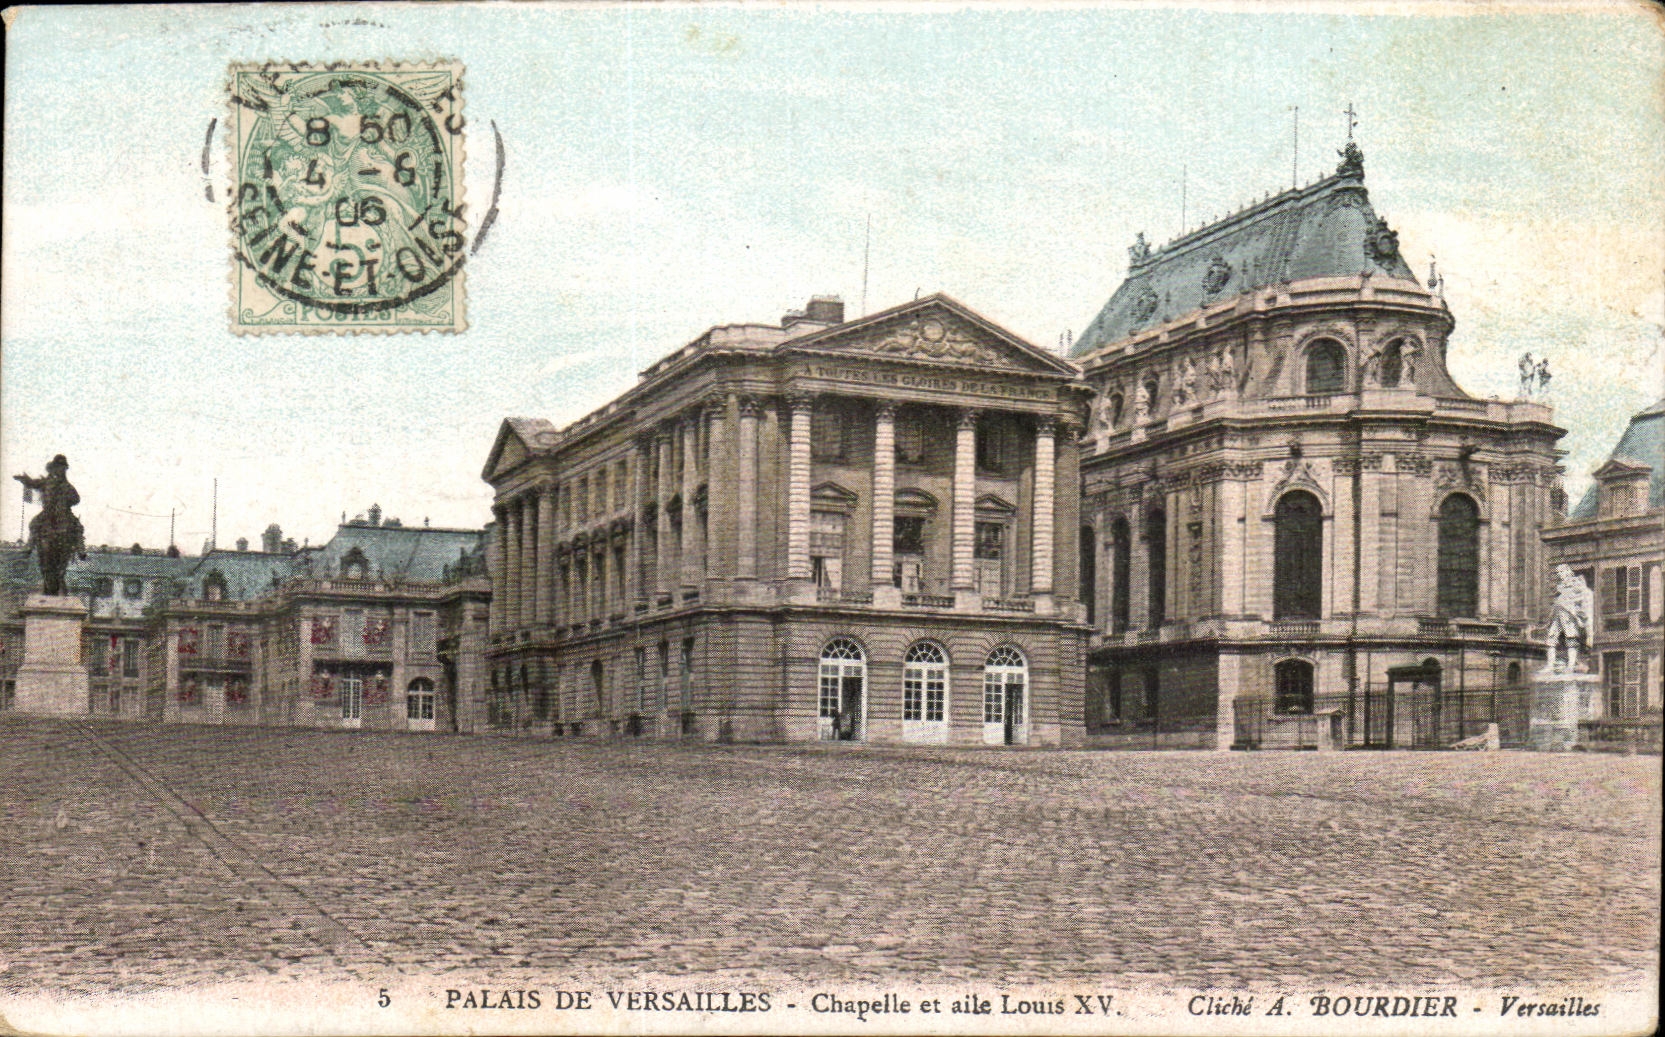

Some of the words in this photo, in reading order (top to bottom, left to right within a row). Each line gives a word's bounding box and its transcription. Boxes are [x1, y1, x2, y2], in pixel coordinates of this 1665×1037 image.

[305, 115, 331, 147] 8
[303, 158, 326, 190] 4
[335, 195, 387, 227] 06
